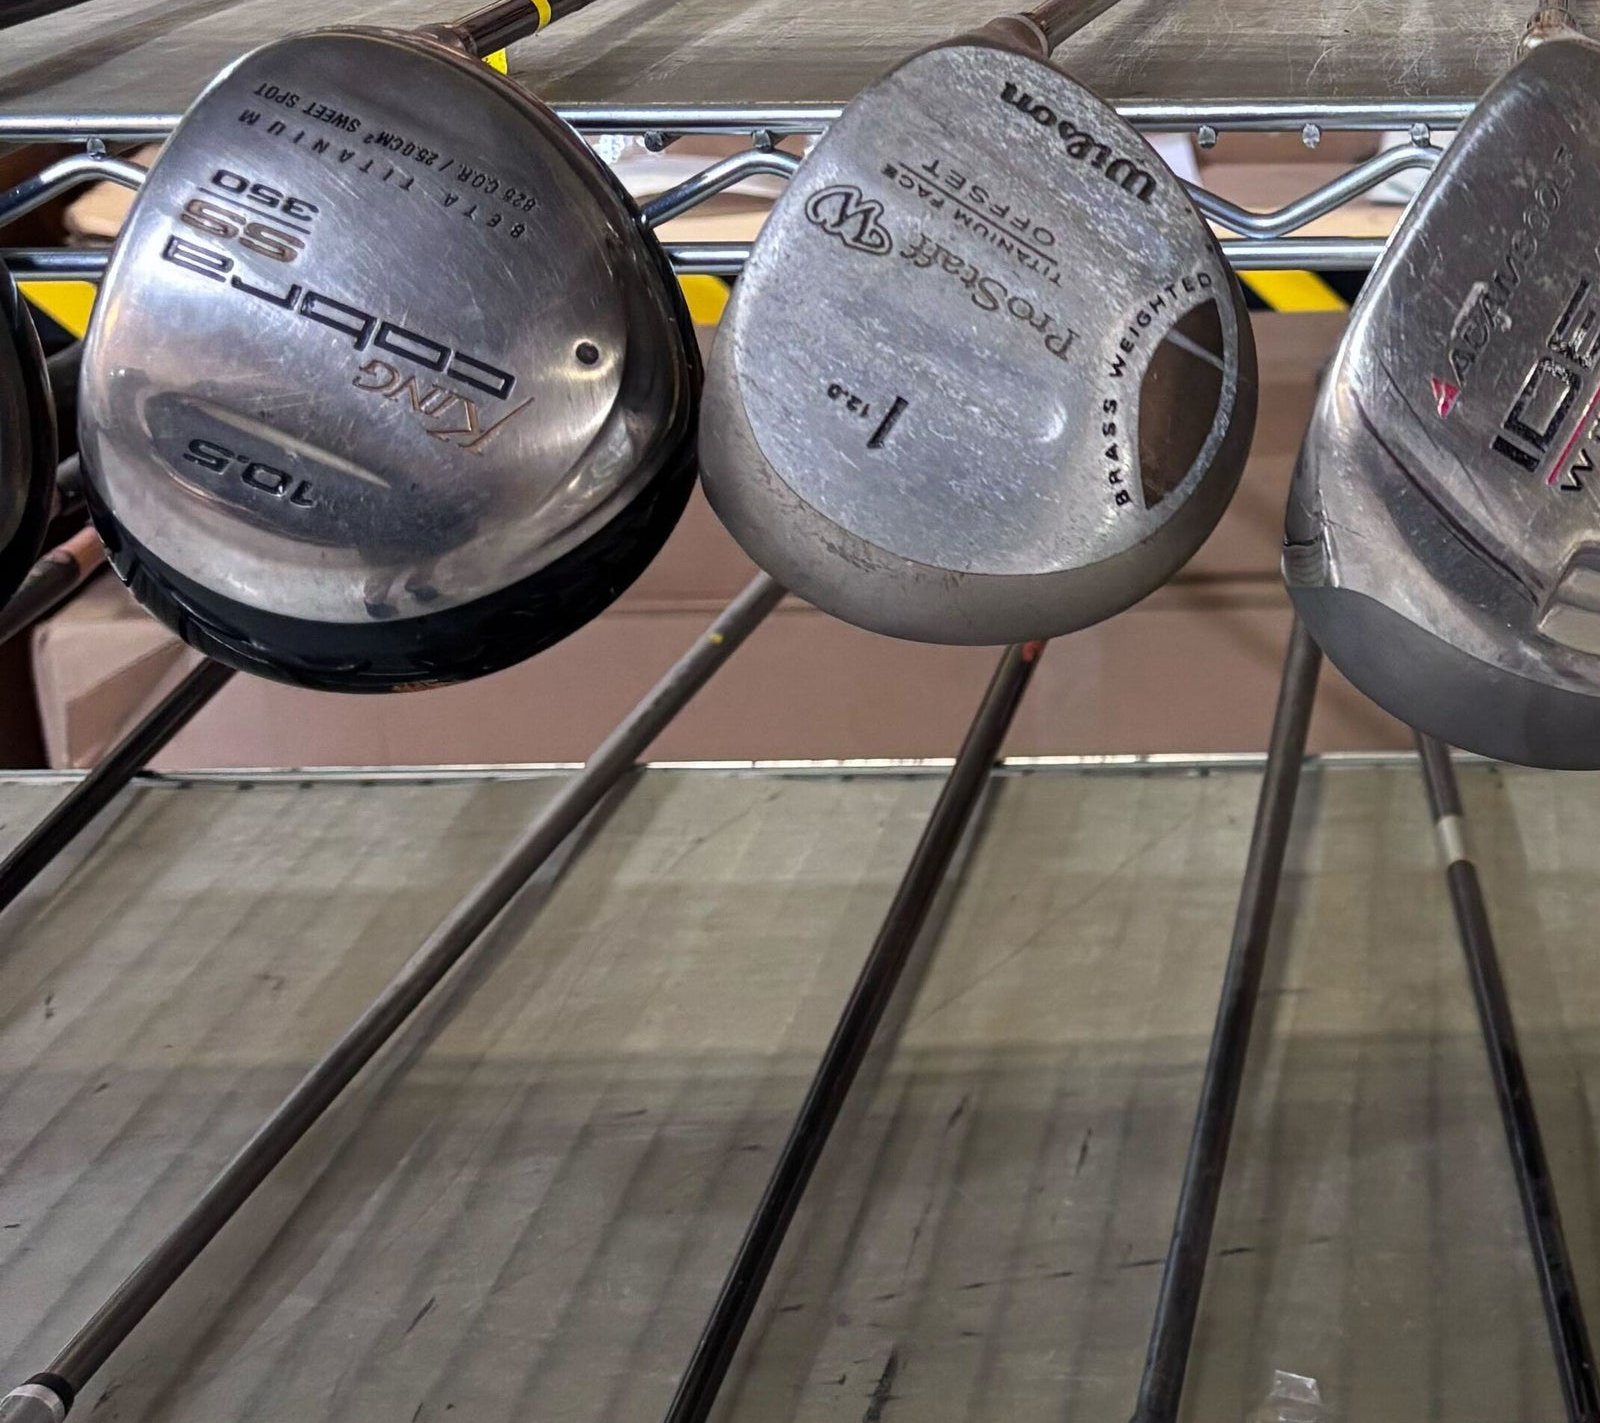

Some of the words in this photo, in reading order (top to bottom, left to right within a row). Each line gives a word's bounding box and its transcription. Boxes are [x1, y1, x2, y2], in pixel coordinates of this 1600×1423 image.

[254, 83, 300, 108] SPOT
[303, 102, 360, 132] SWEET
[238, 109, 415, 191] TITANIUM
[1000, 82, 1157, 205] Wilson
[211, 168, 319, 222] 350
[443, 191, 526, 238] BETA
[882, 162, 945, 209] FACE
[922, 158, 1056, 247] OFFSET
[180, 198, 306, 263] SS
[953, 209, 1064, 288] TITANIUM
[900, 233, 1081, 362] ProStaff
[1109, 272, 1212, 378] WEIGHTED
[352, 360, 535, 455] KING
[828, 383, 870, 418] 12.0
[867, 395, 909, 449] 1
[183, 439, 316, 507] 10.5
[1102, 399, 1131, 506] BRASS
